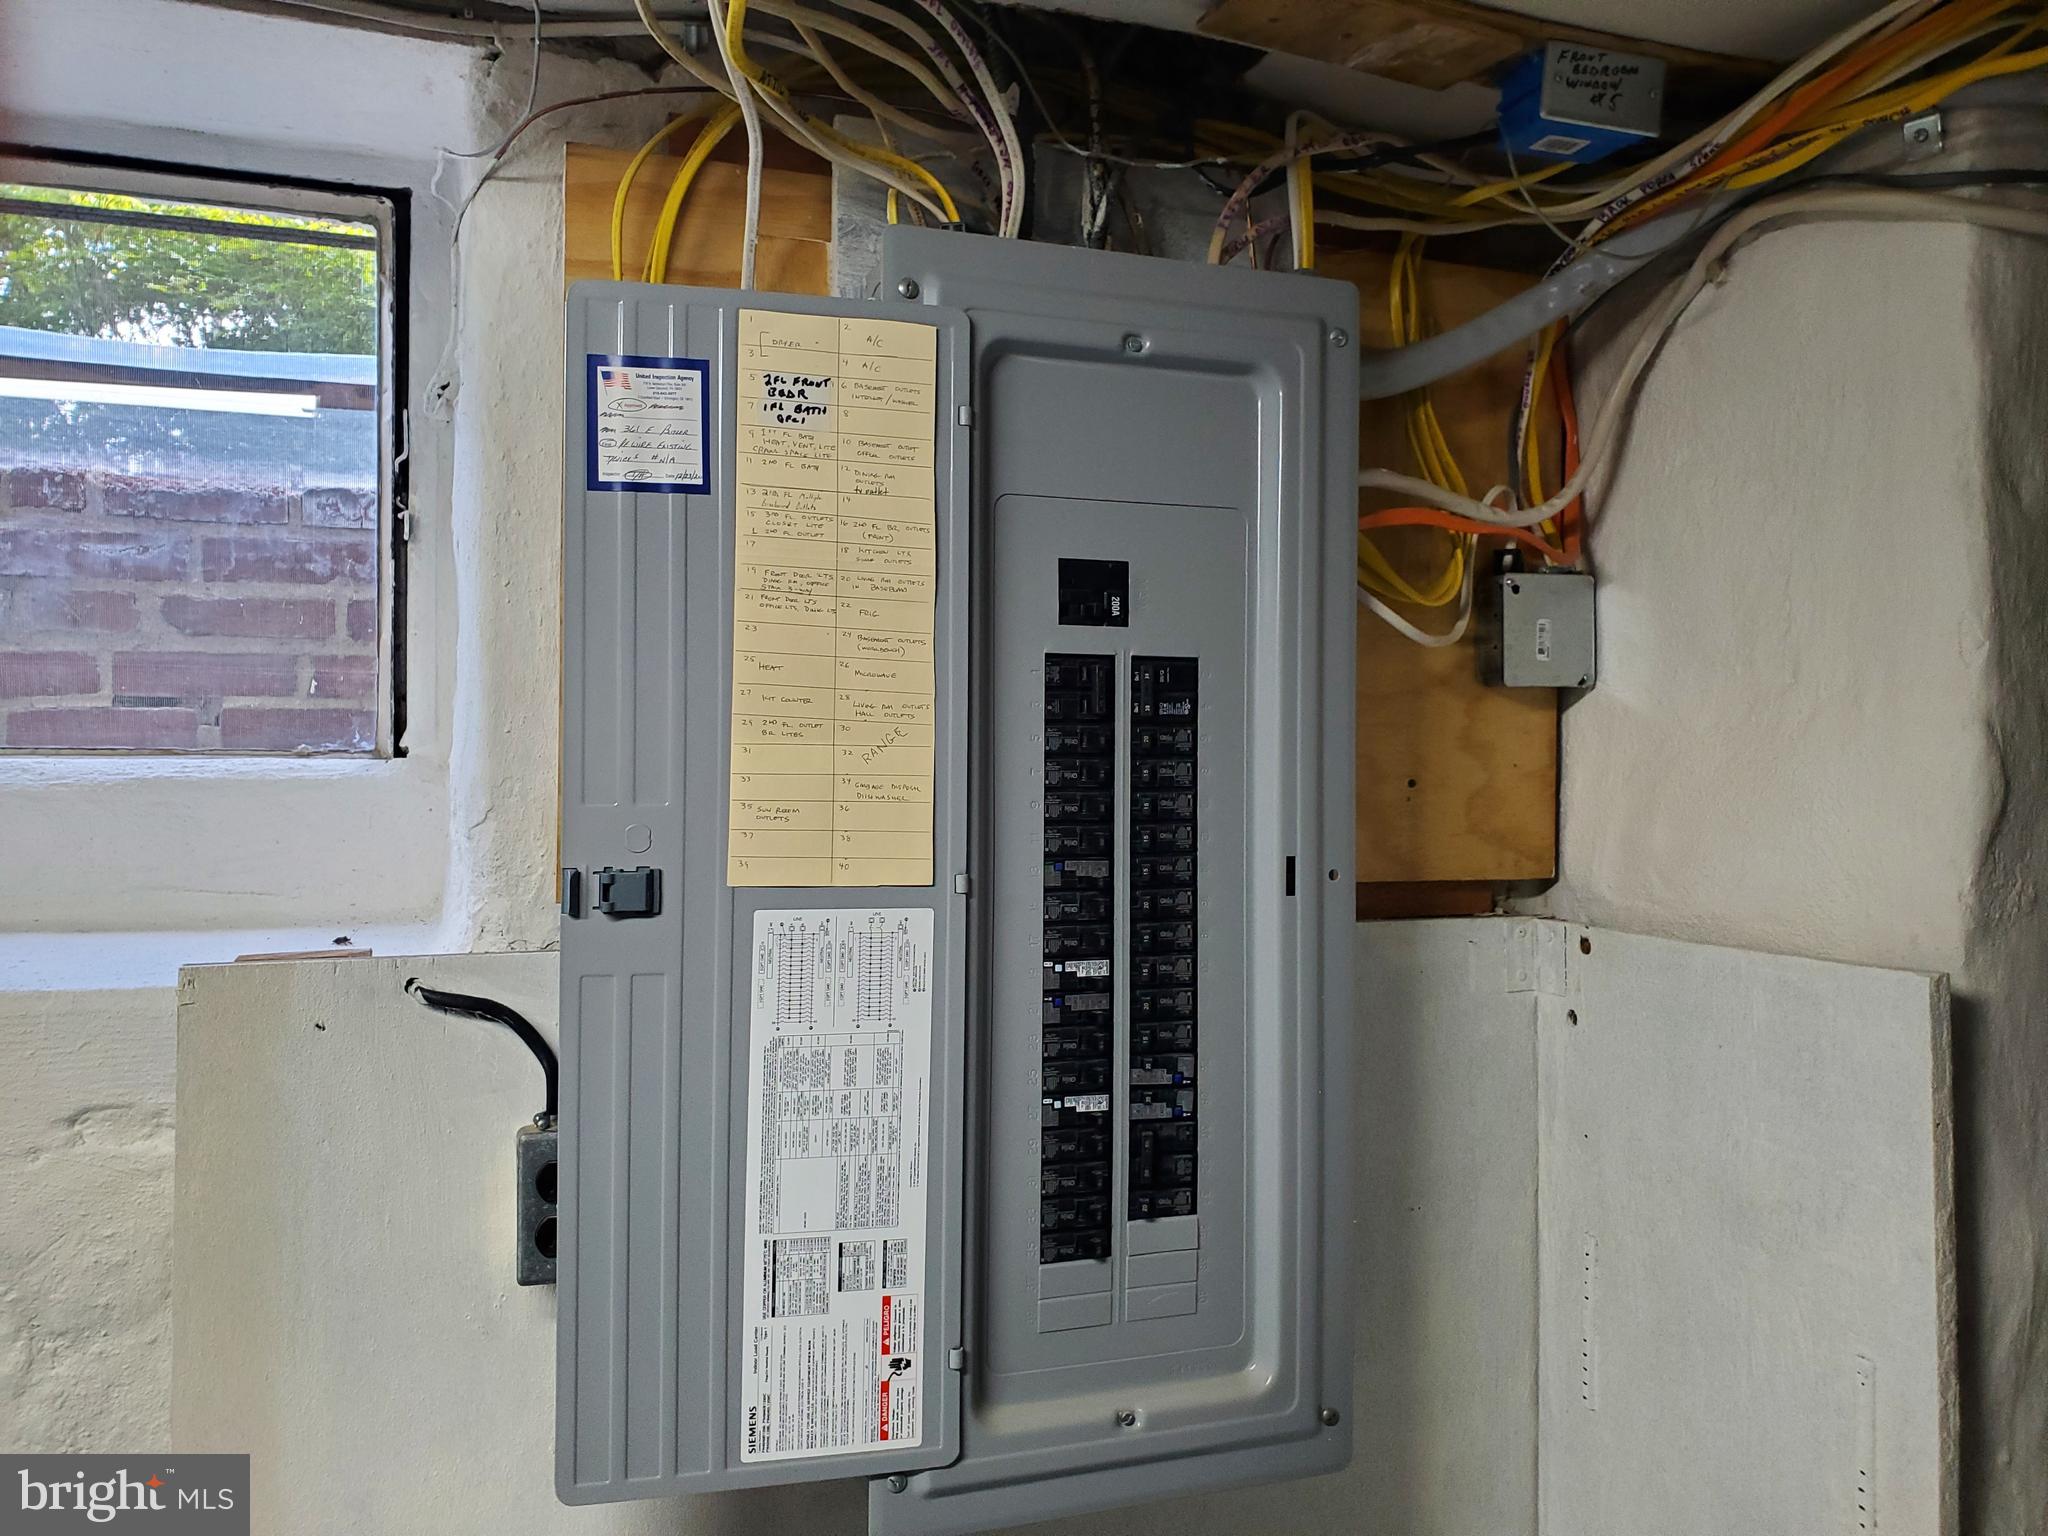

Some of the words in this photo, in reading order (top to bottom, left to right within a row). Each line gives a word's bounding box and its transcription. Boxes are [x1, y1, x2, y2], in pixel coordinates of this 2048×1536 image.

[1558, 50, 1608, 64] FRONT
[1572, 64, 1639, 77] BEDROOM
[1566, 78, 1622, 90] WINDOW
[867, 335, 883, 348] A/C
[749, 349, 754, 357] 3
[862, 361, 880, 373] A/C
[678, 374, 694, 382] Agency
[793, 377, 831, 388] FRONT
[794, 404, 827, 415] BATH
[749, 430, 754, 438] 9
[1111, 596, 1120, 616] 200A
[860, 609, 879, 618] FRIG
[759, 662, 784, 671] HEAT
[861, 726, 909, 765] RANGE
[739, 861, 749, 869] 39
[748, 1406, 757, 1454] SIEMENS
